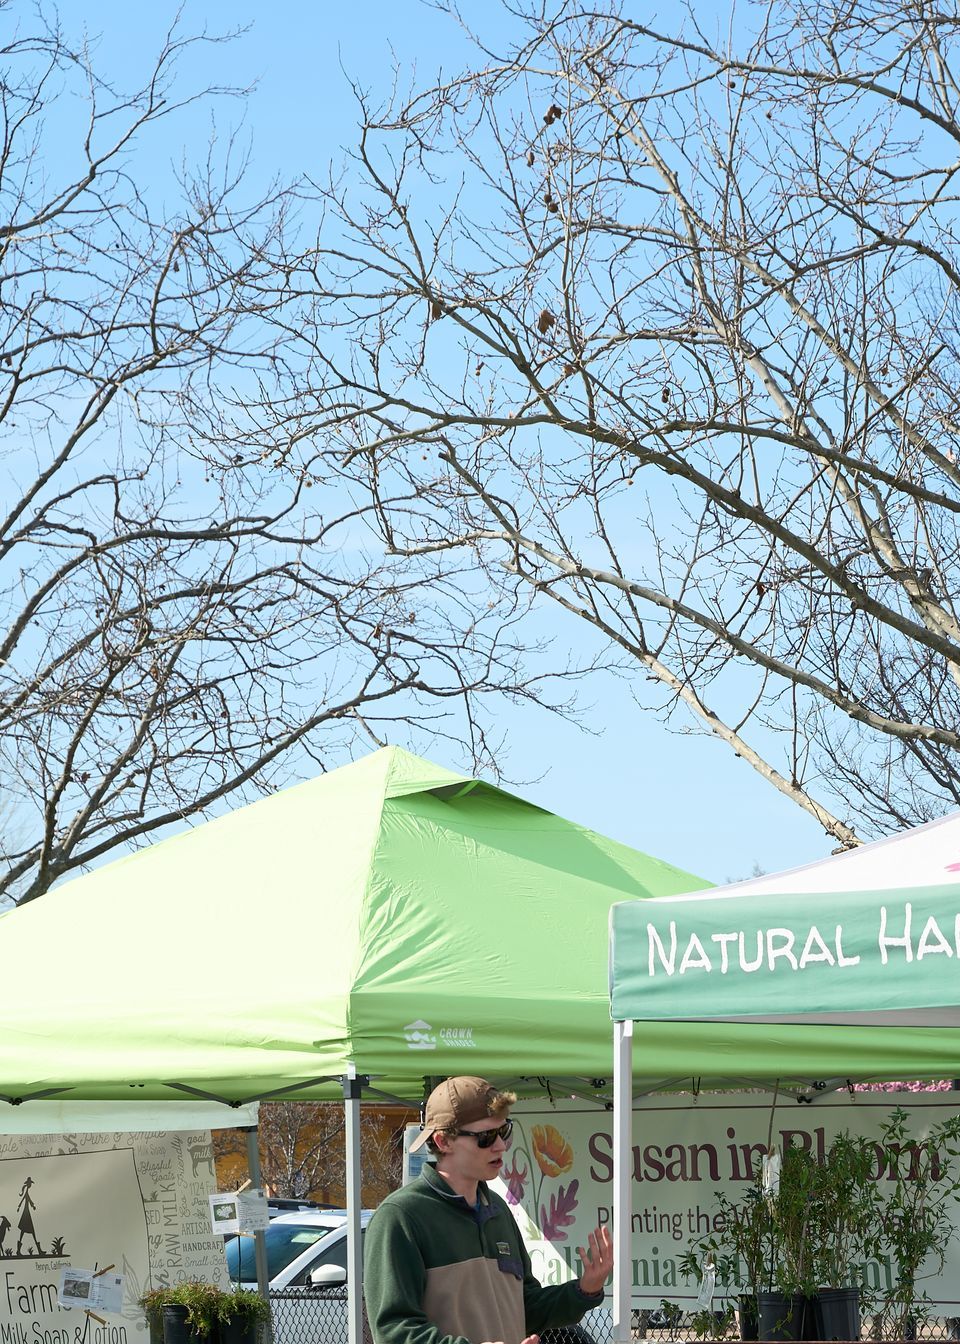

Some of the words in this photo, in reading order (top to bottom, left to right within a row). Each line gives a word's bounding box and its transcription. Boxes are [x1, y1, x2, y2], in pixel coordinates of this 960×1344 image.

[646, 920, 860, 977] NATURAL
[439, 1027, 473, 1039] CROWN
[187, 1133, 206, 1147] goat
[778, 1126, 944, 1183] Blom
[159, 1182, 179, 1226] MILK
[597, 1205, 684, 1241] Plnting
[165, 1232, 182, 1268] RAW
[184, 1255, 209, 1268] Small
[5, 1271, 72, 1315] Farm
